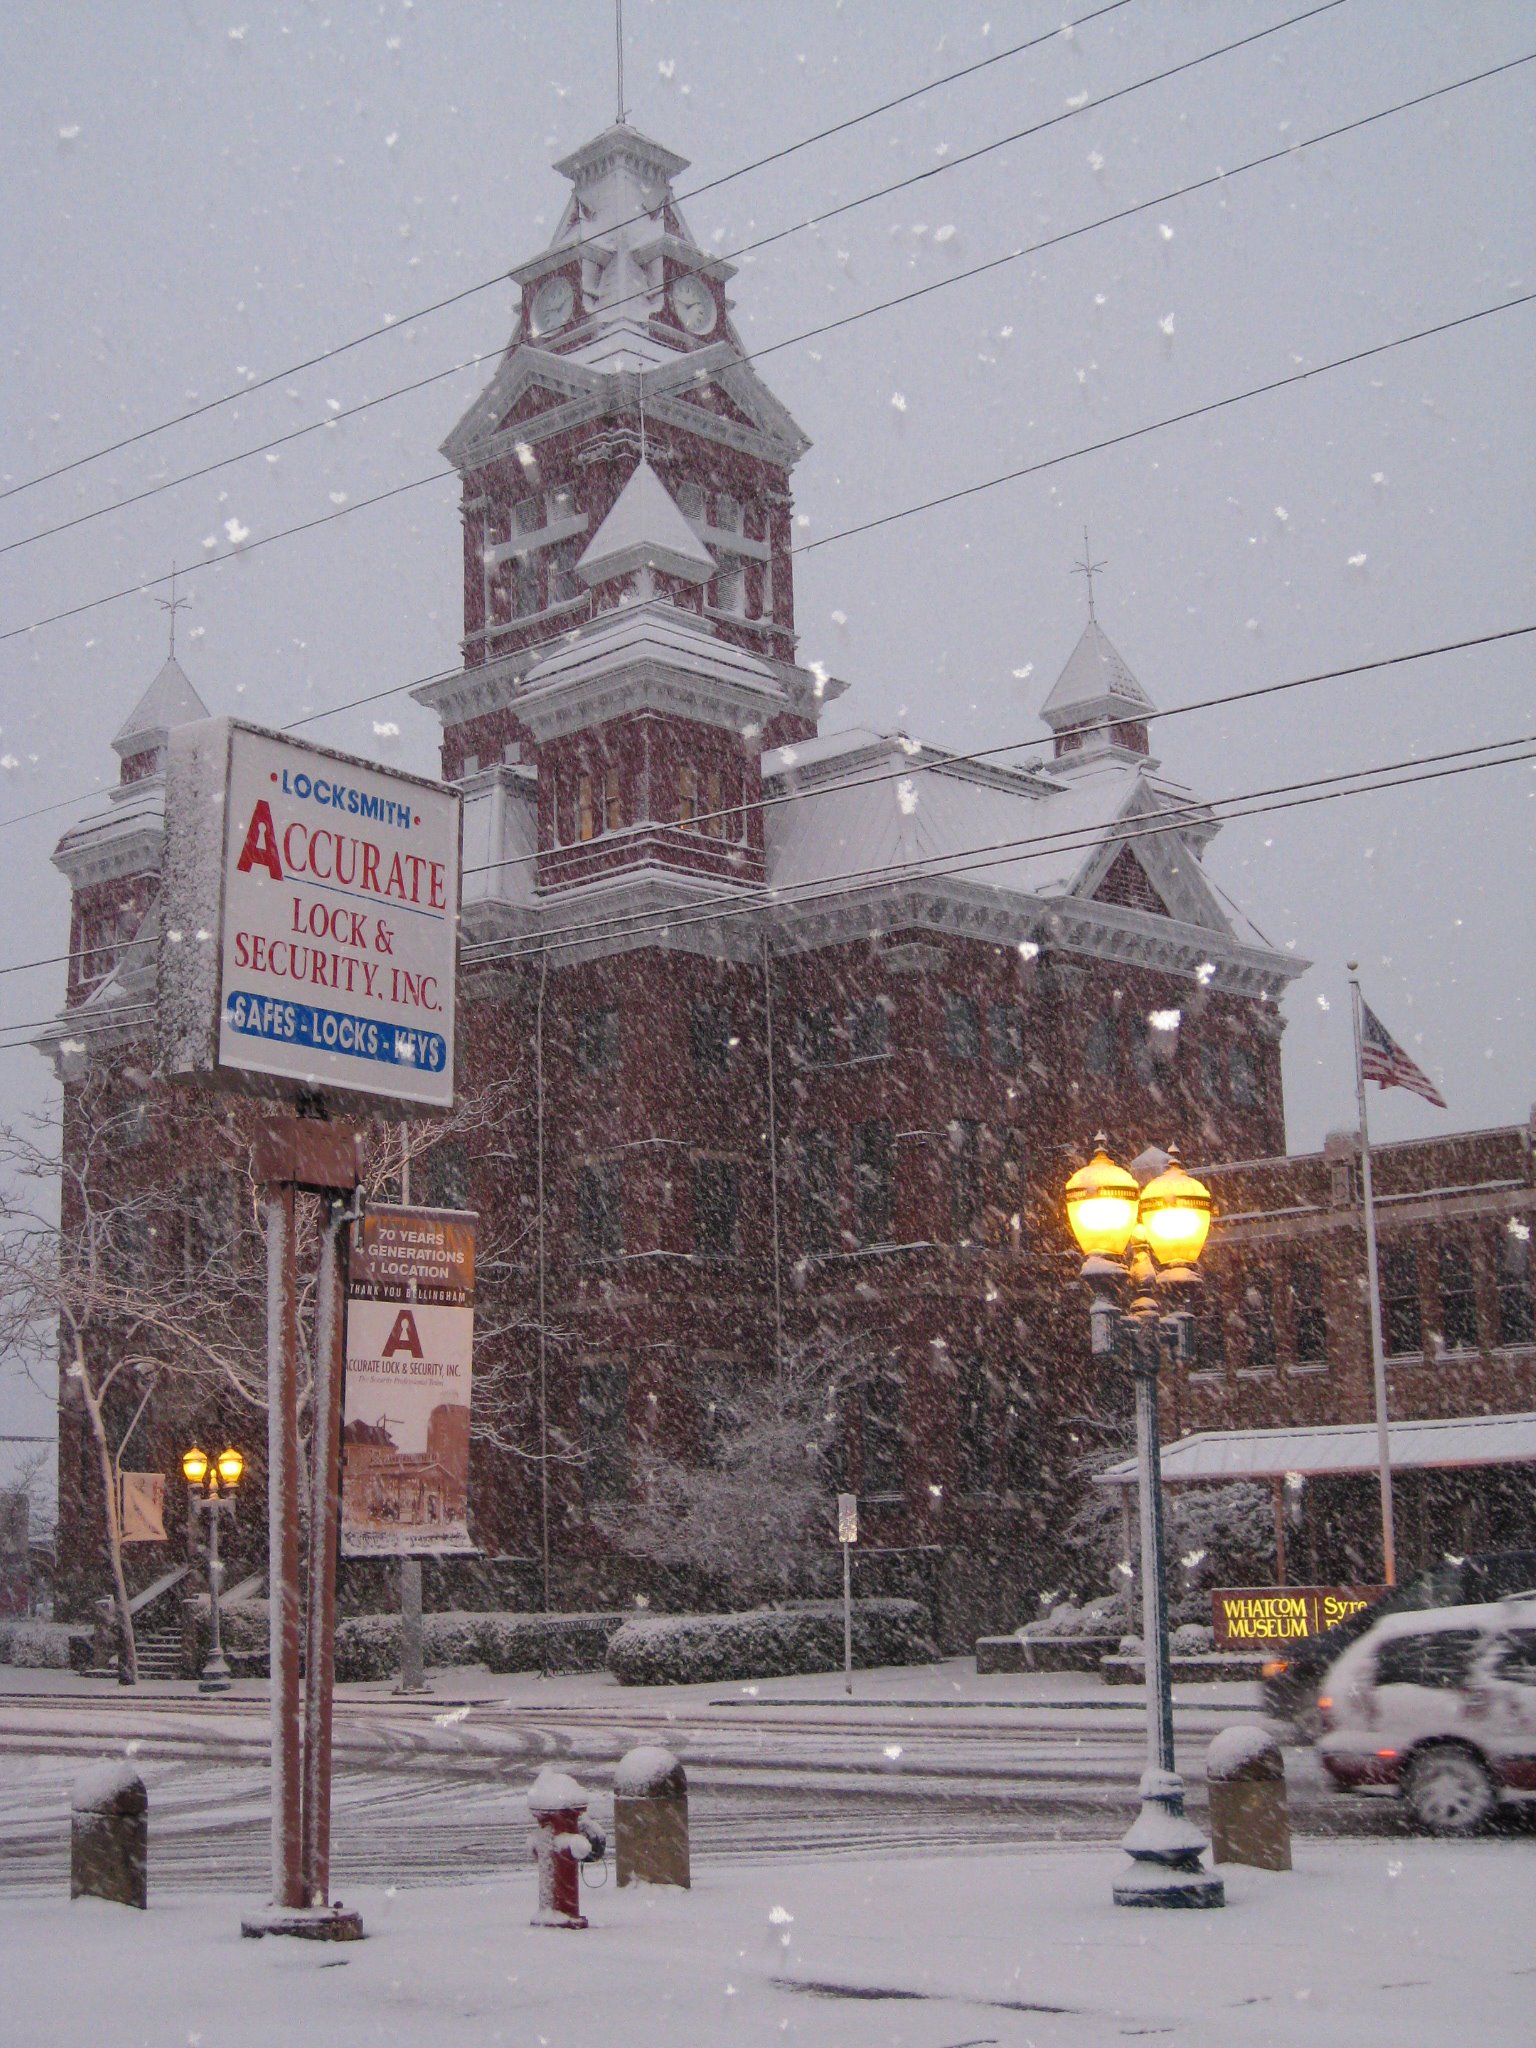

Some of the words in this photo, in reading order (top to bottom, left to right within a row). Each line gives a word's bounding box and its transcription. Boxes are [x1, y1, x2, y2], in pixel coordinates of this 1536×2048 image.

[282, 769, 411, 829] LOCKSMITH
[237, 799, 447, 911] ACCURATE
[291, 897, 368, 949] LOCK
[375, 919, 395, 955] &
[234, 932, 384, 1000] SECURITY,
[390, 968, 443, 1012] INC.
[234, 995, 295, 1038] SAFES
[312, 1015, 378, 1055] LOCKS
[394, 1031, 440, 1067] KEYS
[378, 1228, 396, 1241] 70
[400, 1230, 445, 1246] YEARS
[368, 1244, 465, 1264] GENERATIONS
[370, 1262, 376, 1273] 1
[381, 1263, 449, 1279] LOCATION
[350, 1283, 379, 1296] THANK
[384, 1286, 401, 1298] YOU
[406, 1288, 466, 1303] BELLINGHAM
[381, 1309, 424, 1358] A
[382, 1360, 400, 1374] LOCK
[402, 1363, 408, 1375] &
[446, 1364, 461, 1377] INC.
[1223, 1598, 1308, 1618] WHATCOM
[1228, 1618, 1309, 1638] MUSEUM
